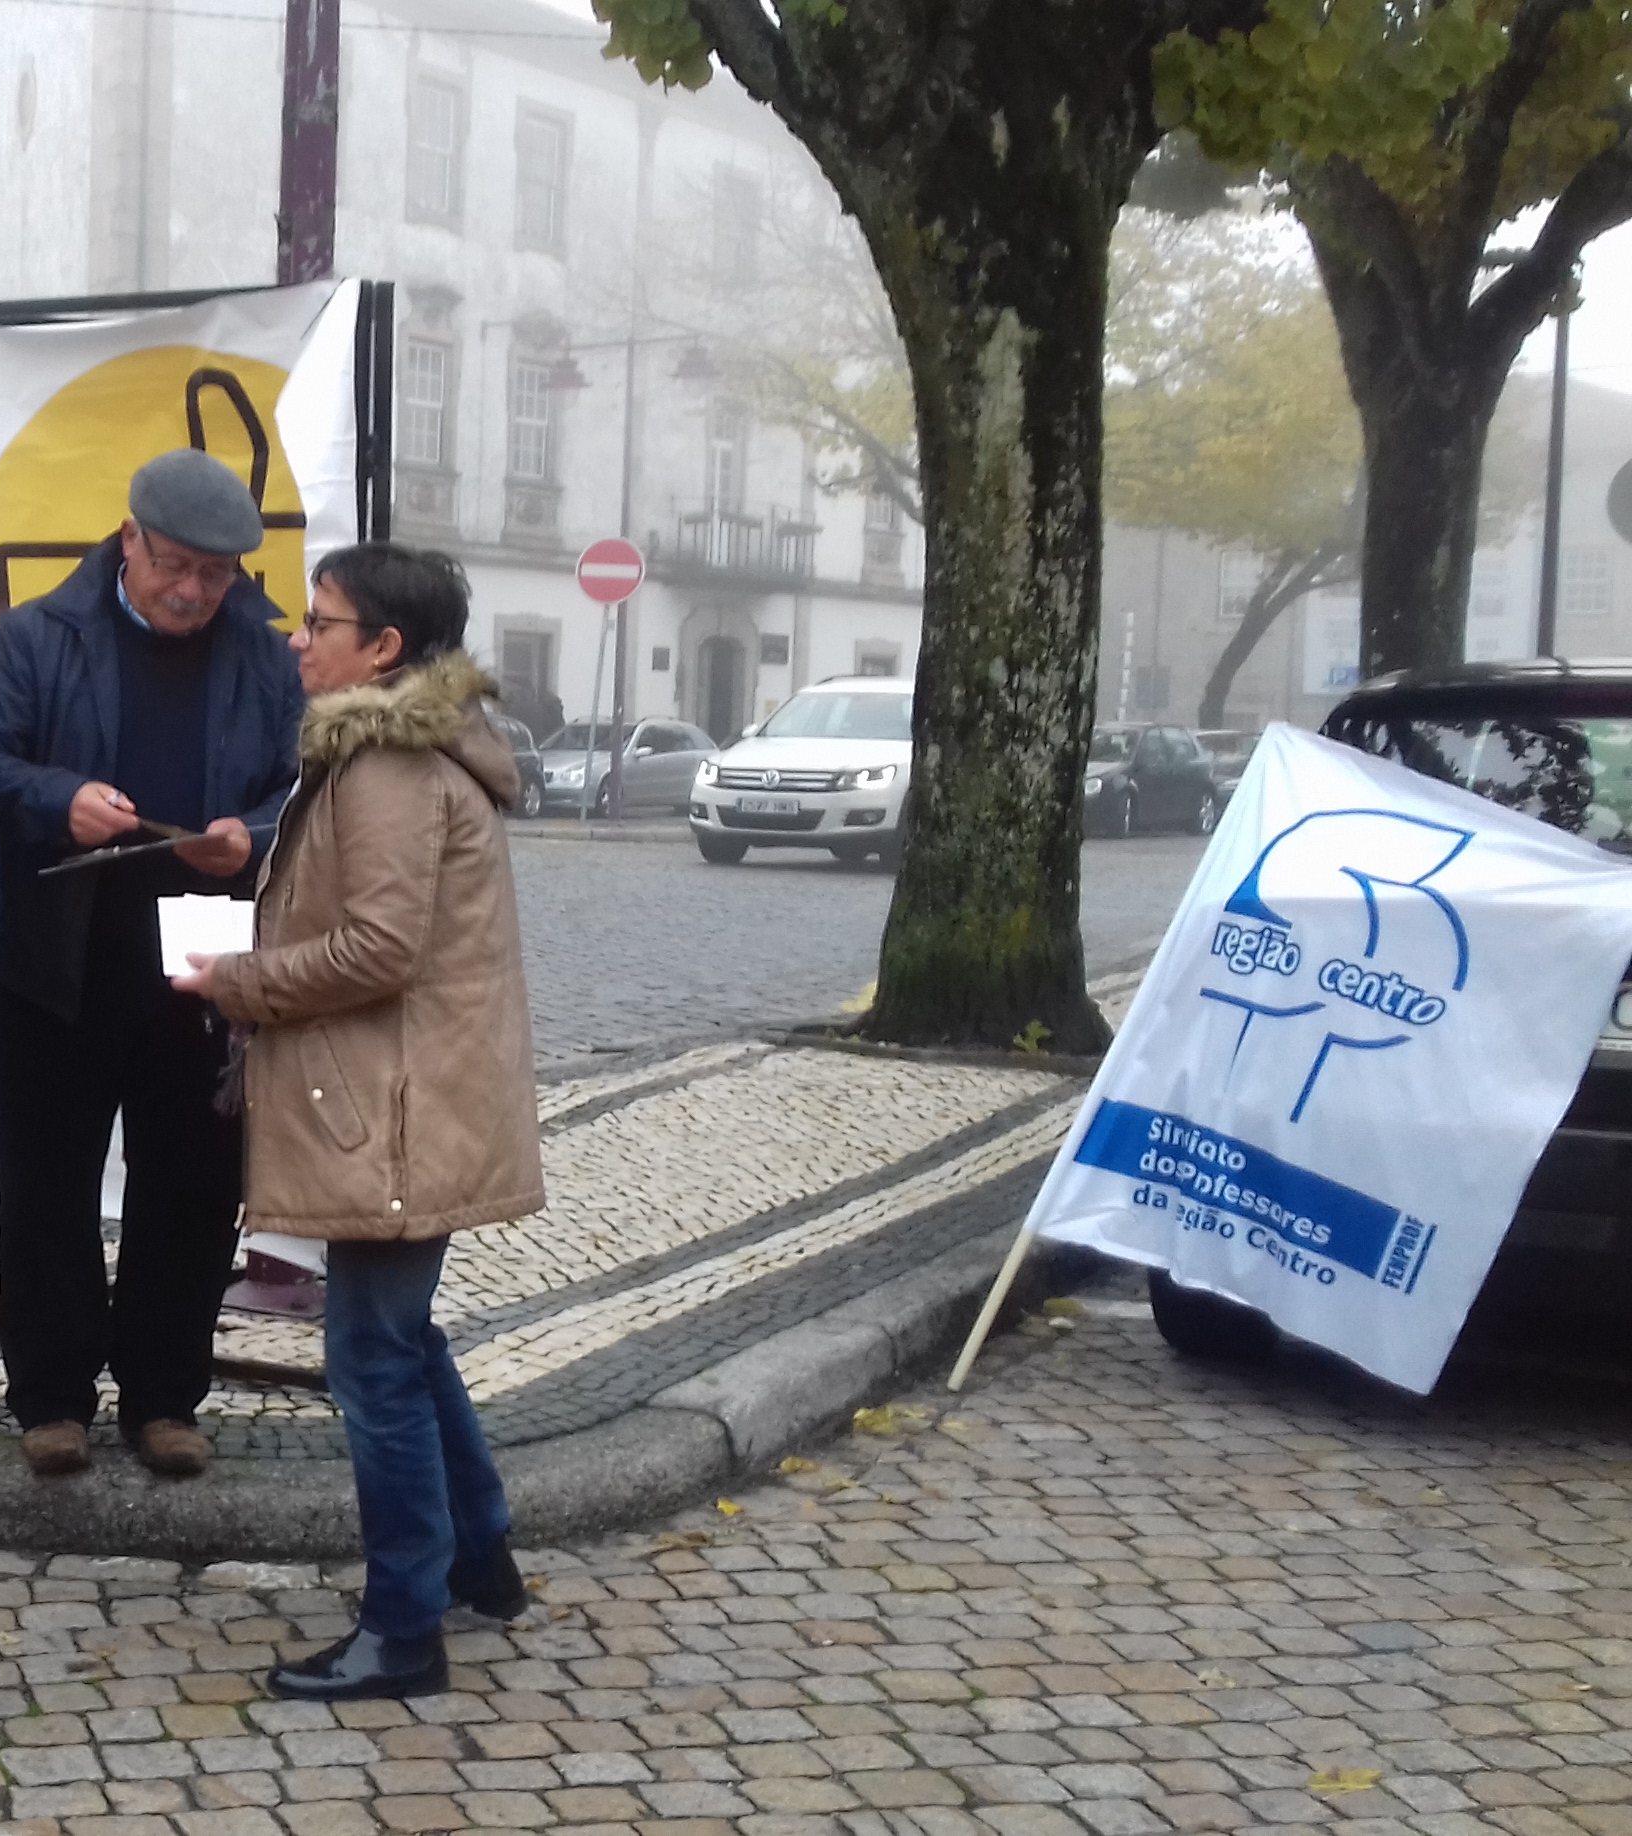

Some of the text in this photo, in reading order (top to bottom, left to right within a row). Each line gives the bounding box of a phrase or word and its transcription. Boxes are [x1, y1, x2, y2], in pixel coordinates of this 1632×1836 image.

[1211, 921, 1445, 1024] região centro
[1133, 1184, 1337, 1286] da egião Centro
